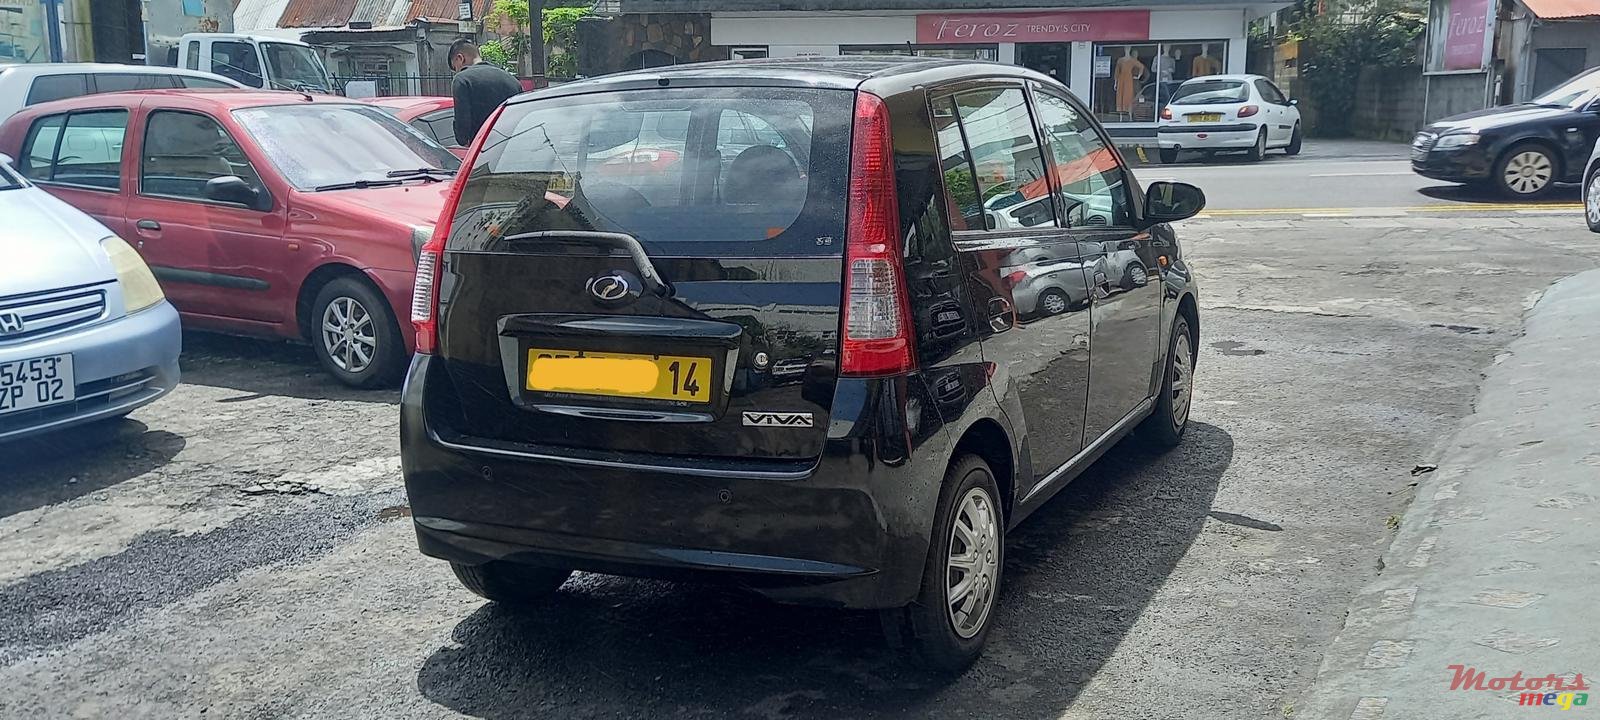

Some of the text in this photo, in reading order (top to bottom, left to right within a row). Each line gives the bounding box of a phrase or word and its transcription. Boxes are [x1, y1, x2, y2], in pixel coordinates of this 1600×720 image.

[932, 19, 1091, 40] Feroz TRENDY'S CITY
[0, 357, 57, 386] 5453
[668, 361, 700, 396] 14
[0, 378, 64, 410] ZP 02
